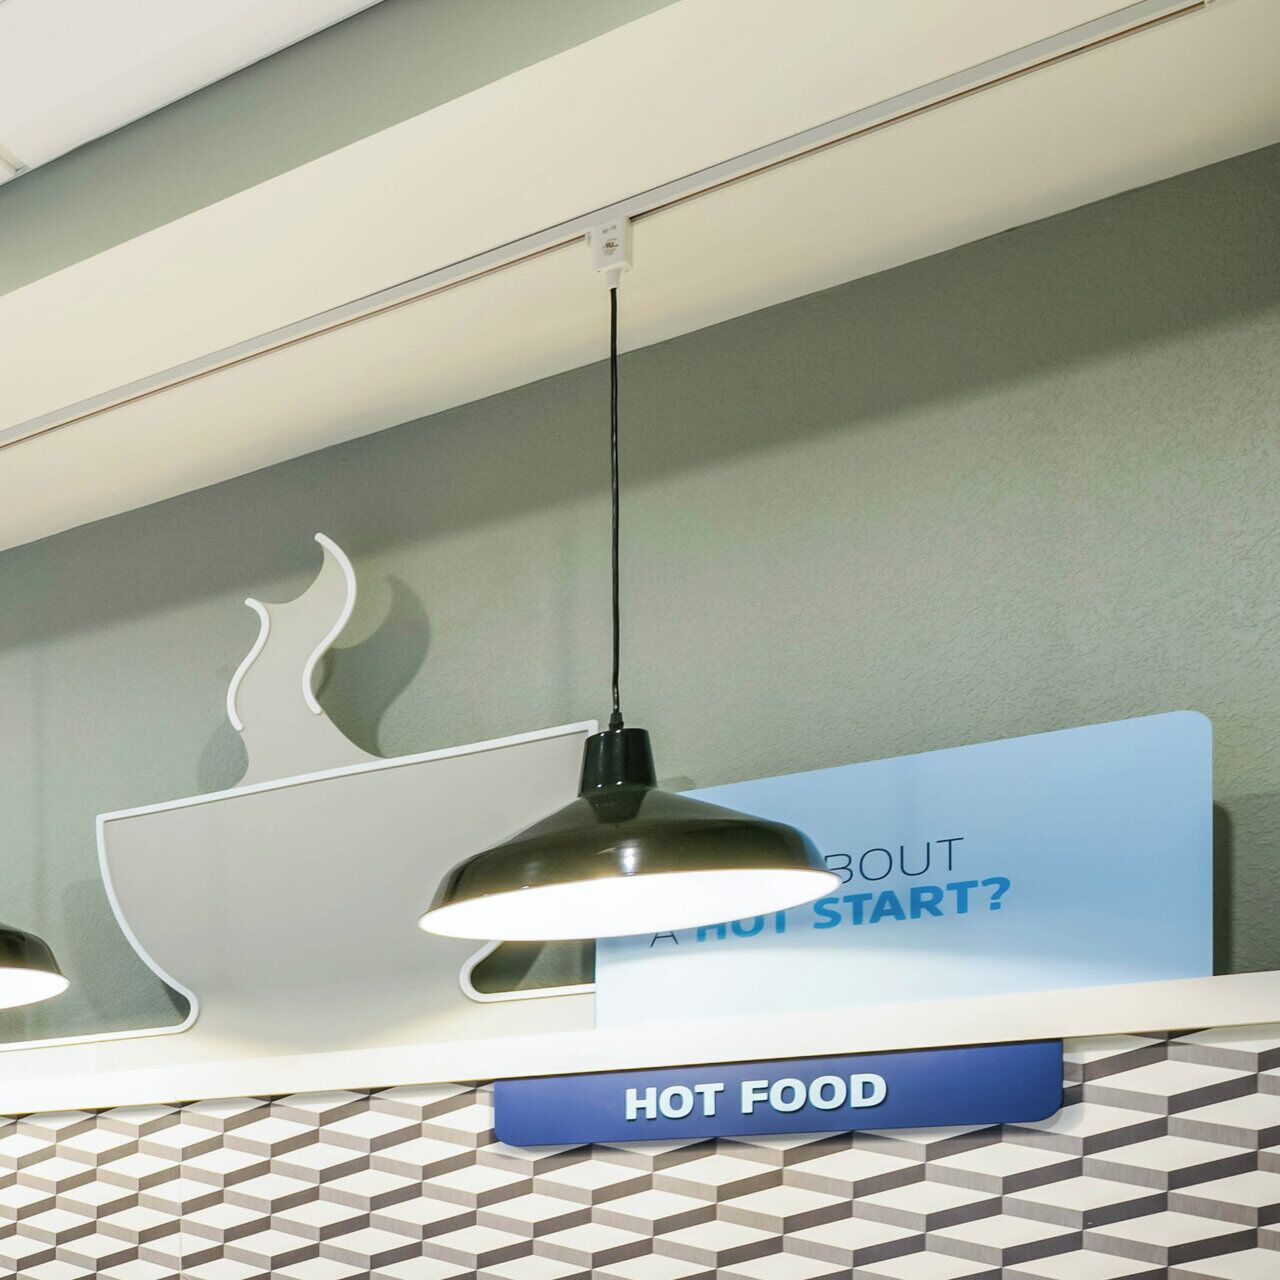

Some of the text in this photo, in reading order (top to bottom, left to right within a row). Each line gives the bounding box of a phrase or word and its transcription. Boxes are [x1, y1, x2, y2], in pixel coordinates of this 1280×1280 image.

[823, 837, 964, 885] BOUT
[813, 876, 1011, 930] START?
[625, 1073, 887, 1120] HOT FOOD
